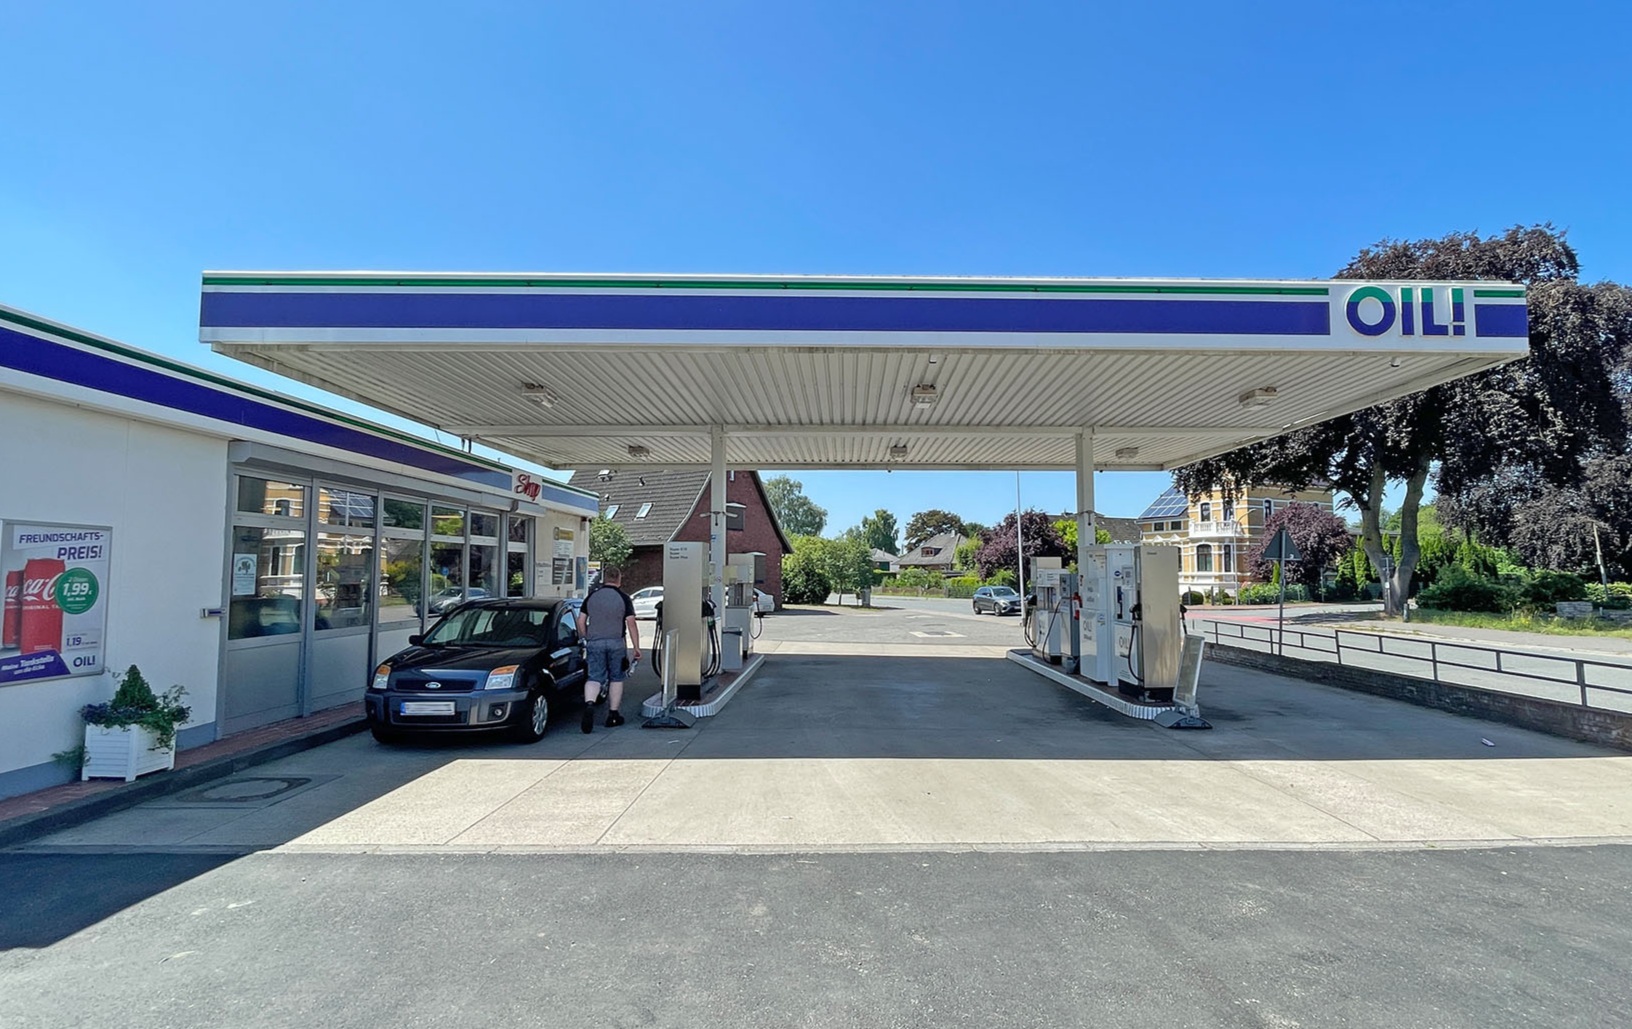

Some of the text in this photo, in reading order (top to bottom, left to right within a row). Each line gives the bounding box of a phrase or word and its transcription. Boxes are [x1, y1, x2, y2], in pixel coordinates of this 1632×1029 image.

[1344, 286, 1465, 336] OIL!
[19, 531, 104, 544] FREUNDSCHAFTS-
[57, 545, 102, 560] PREIS!
[63, 582, 89, 597] 1,99
[73, 655, 96, 668] OIL!
